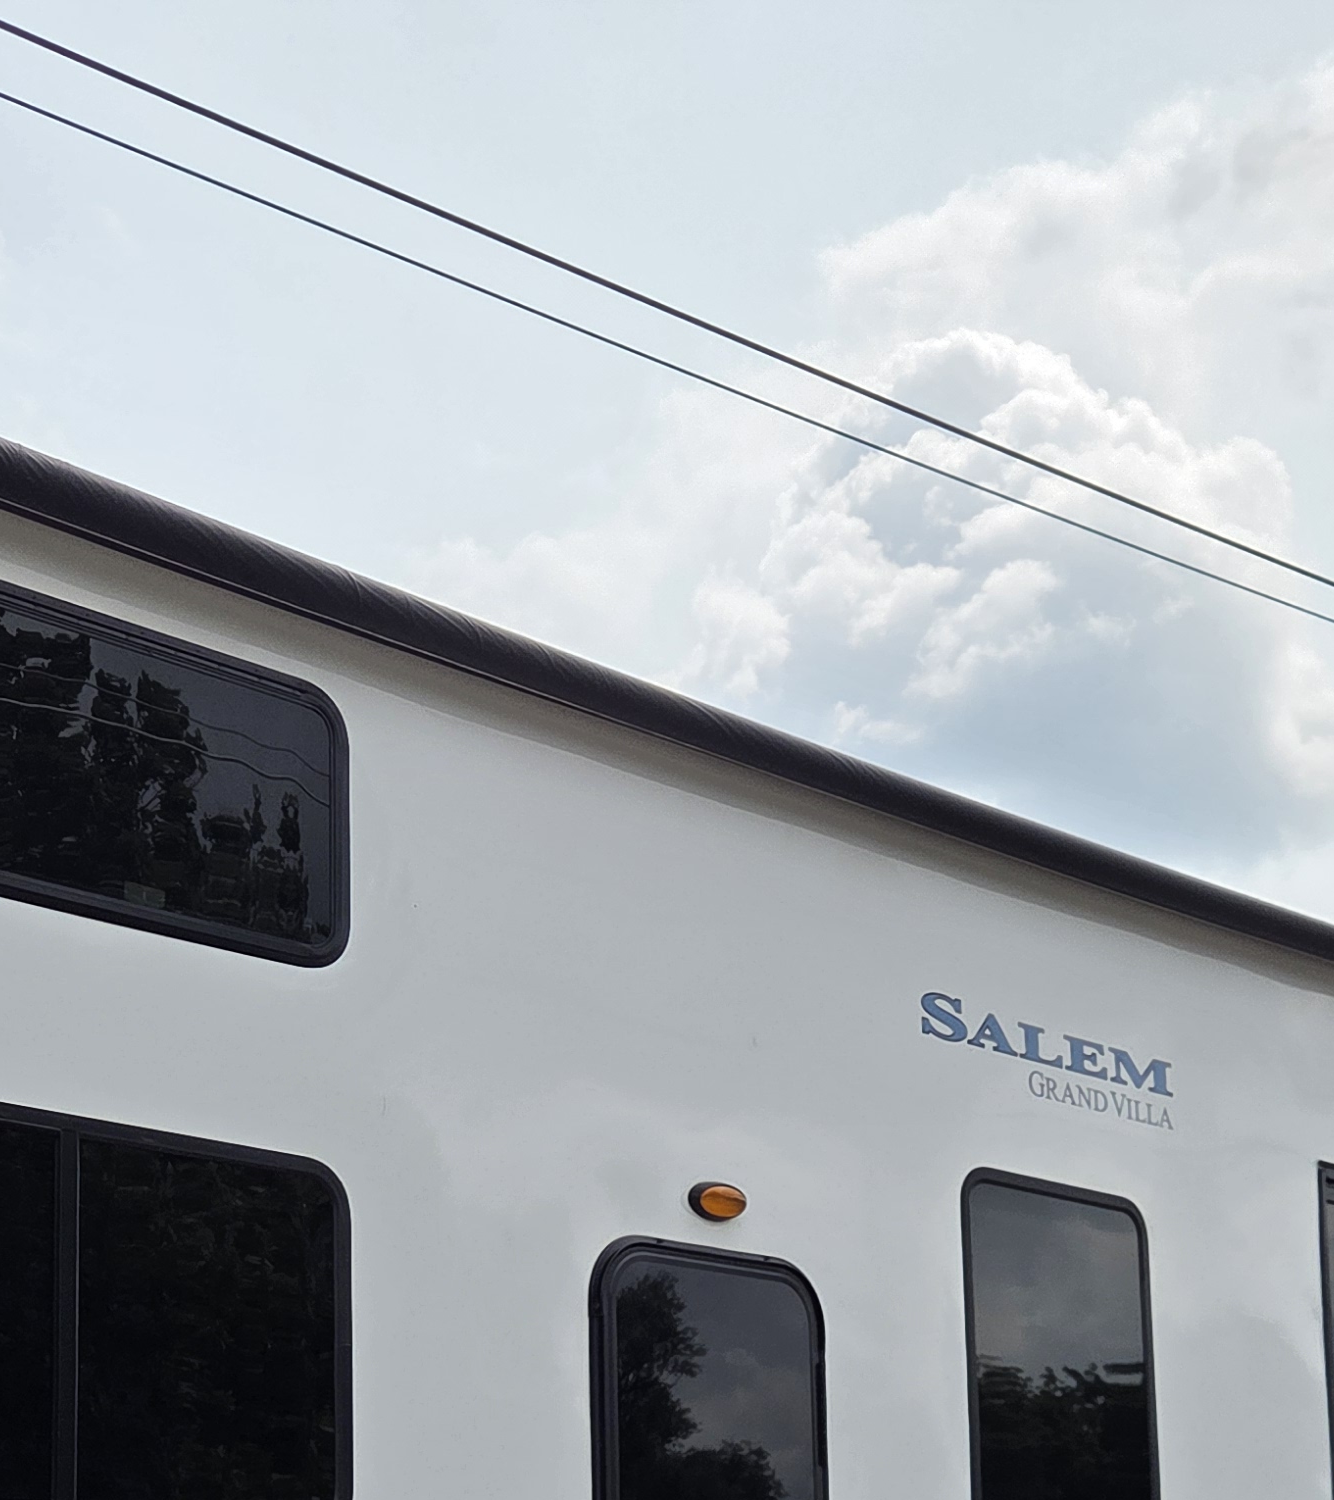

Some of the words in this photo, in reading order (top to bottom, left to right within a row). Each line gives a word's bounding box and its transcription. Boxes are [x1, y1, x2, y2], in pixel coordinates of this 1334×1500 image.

[920, 991, 1174, 1098] SALEM
[1028, 1070, 1109, 1113] GRAND
[1110, 1090, 1174, 1131] VILLA
